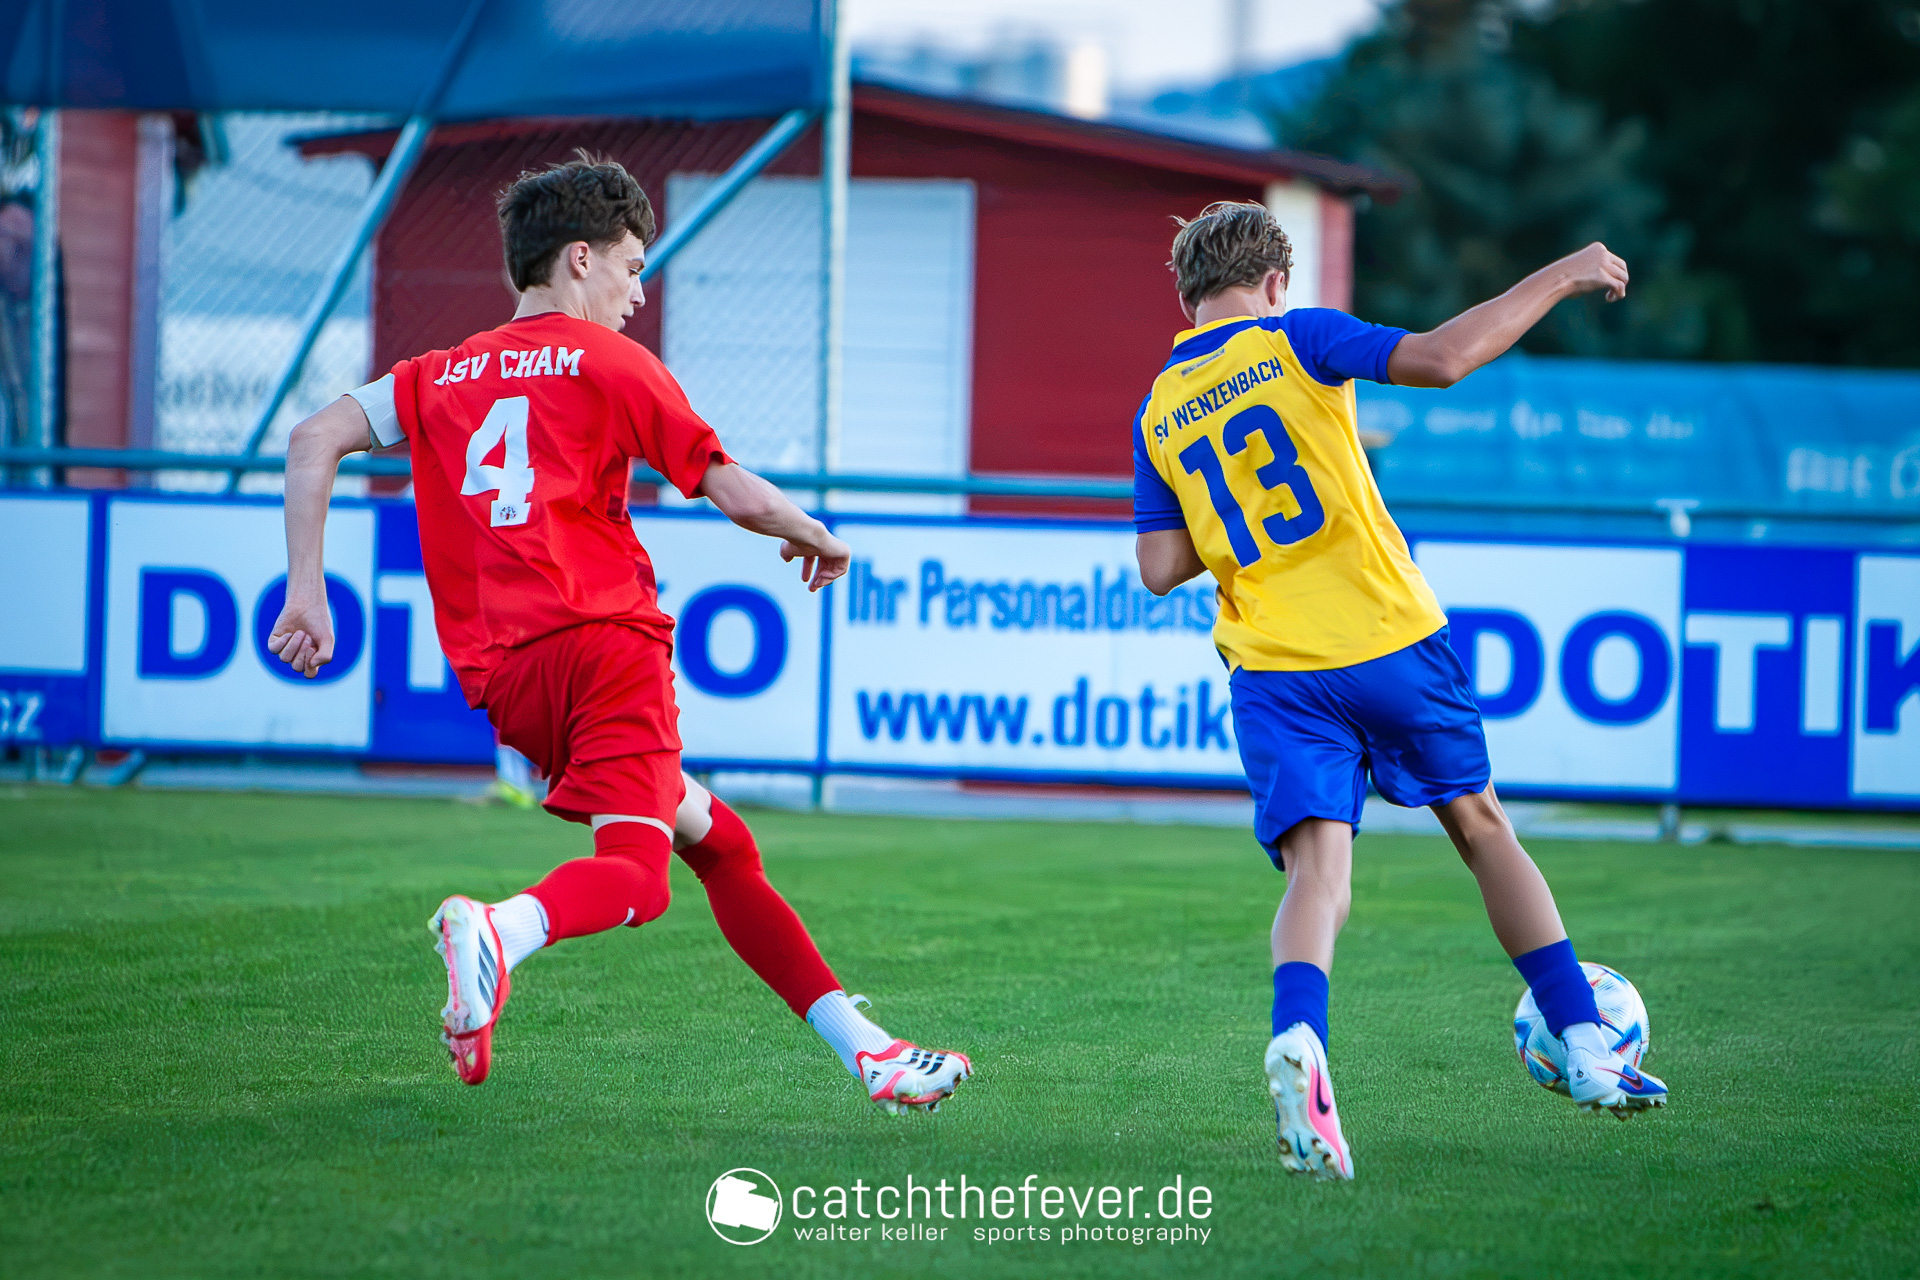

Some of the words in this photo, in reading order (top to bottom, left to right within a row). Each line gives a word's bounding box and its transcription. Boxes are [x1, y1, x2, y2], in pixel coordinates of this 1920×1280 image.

[500, 346, 585, 379] CHAM
[1172, 356, 1284, 430] WENZENBACH
[460, 396, 535, 527] 4
[1178, 404, 1325, 568] 13
[848, 557, 907, 625] Ihr
